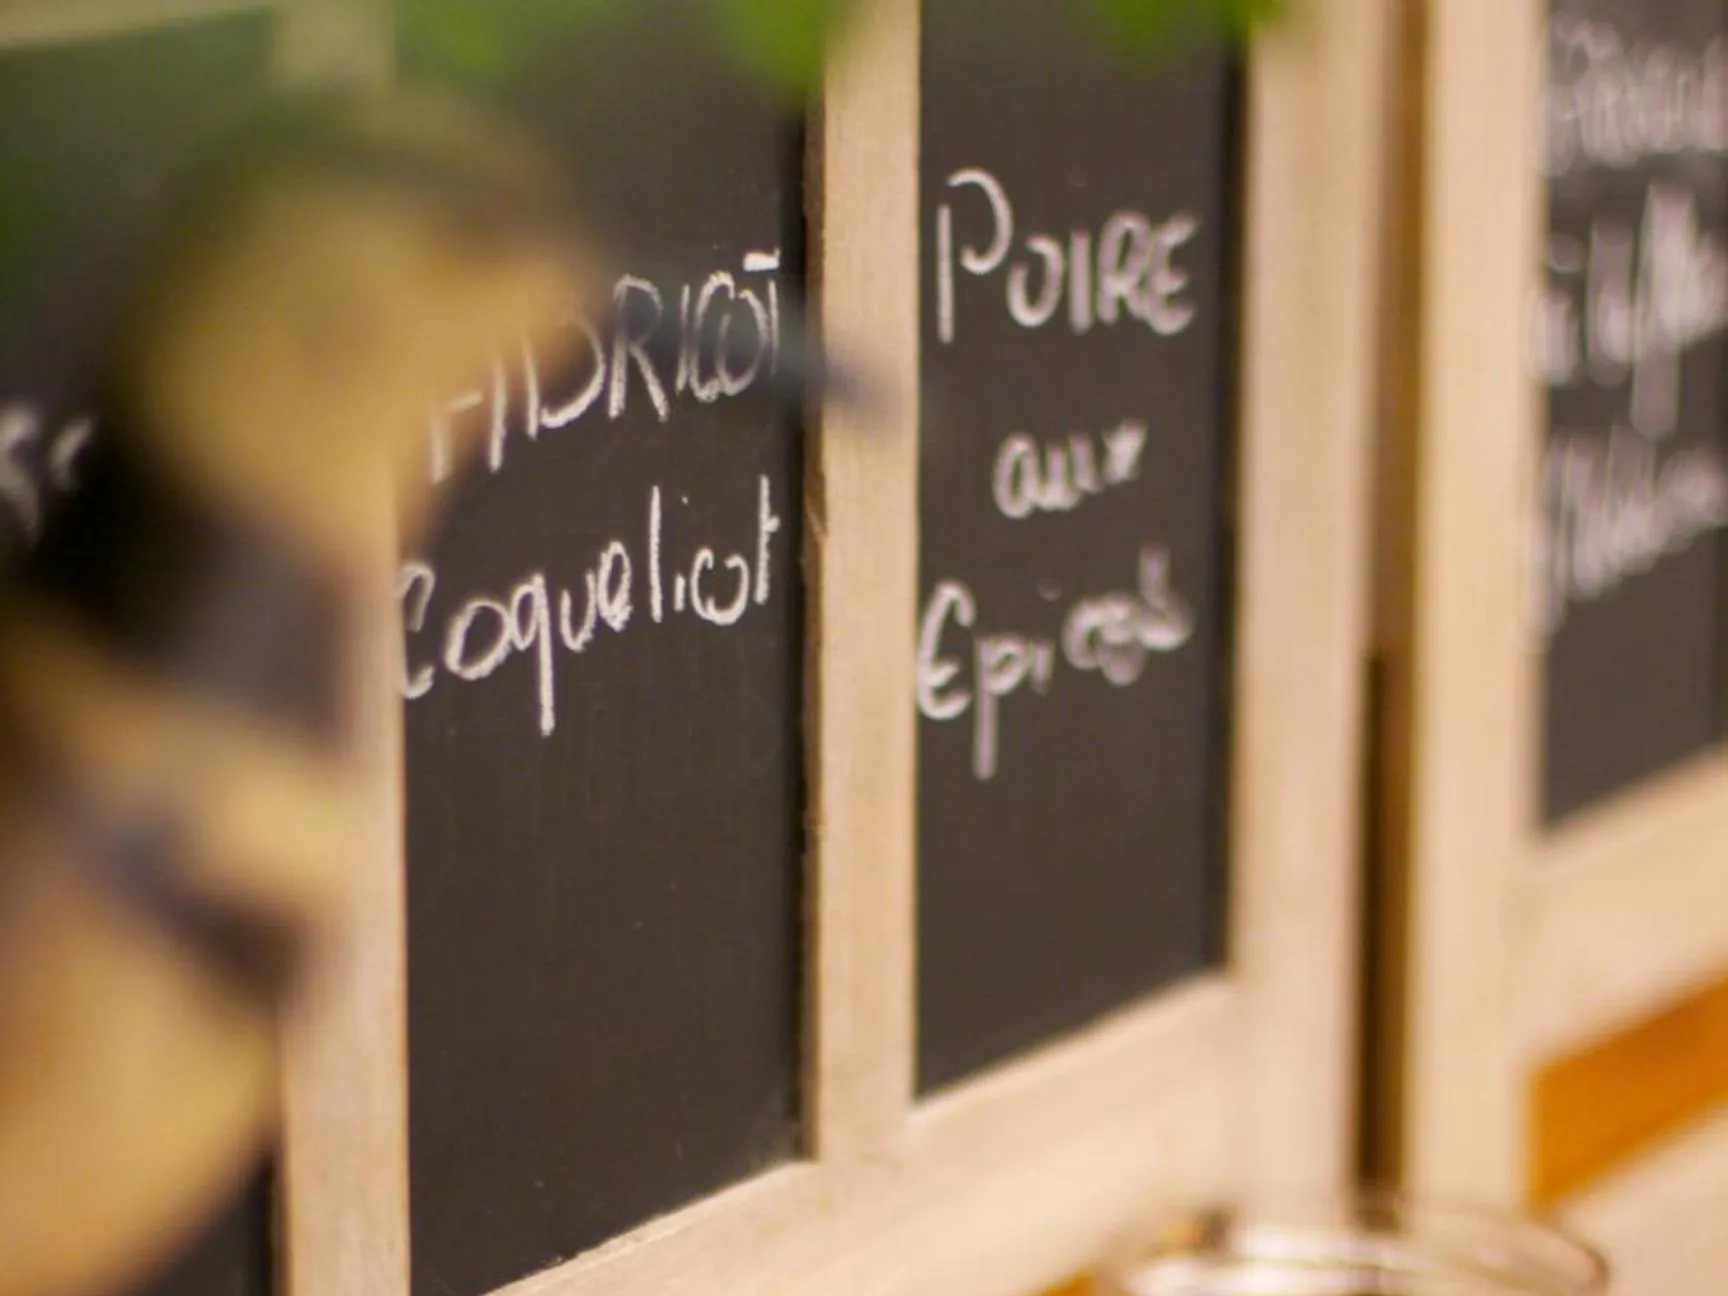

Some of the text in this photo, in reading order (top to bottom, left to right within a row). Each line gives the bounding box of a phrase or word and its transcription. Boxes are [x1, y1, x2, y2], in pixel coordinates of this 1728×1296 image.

[936, 168, 1197, 345] POIRE
[993, 418, 1148, 520] aux
[400, 474, 780, 736] Coquelicot
